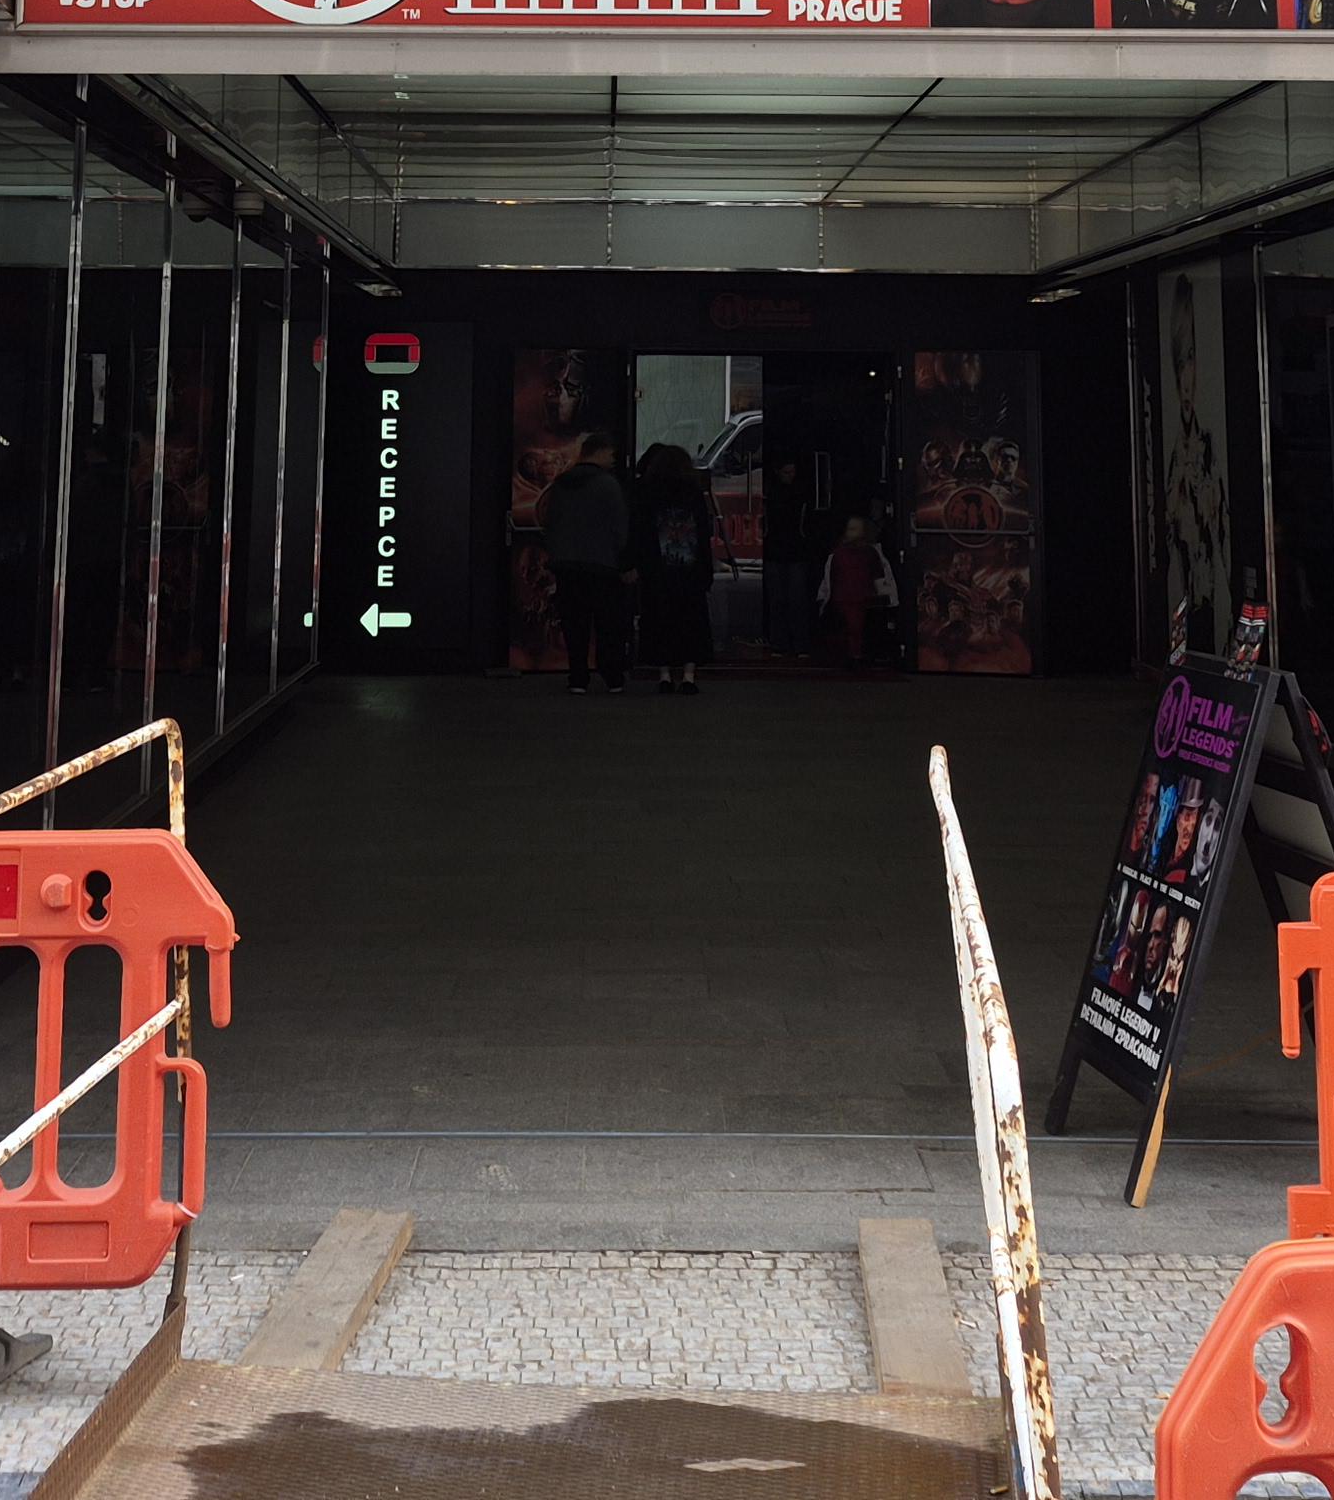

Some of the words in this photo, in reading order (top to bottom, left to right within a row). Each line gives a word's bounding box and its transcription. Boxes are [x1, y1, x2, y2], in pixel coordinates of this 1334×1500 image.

[377, 388, 401, 588] RECEPCE
[1186, 695, 1235, 732] FILM
[1181, 726, 1236, 759] LEGENDS
